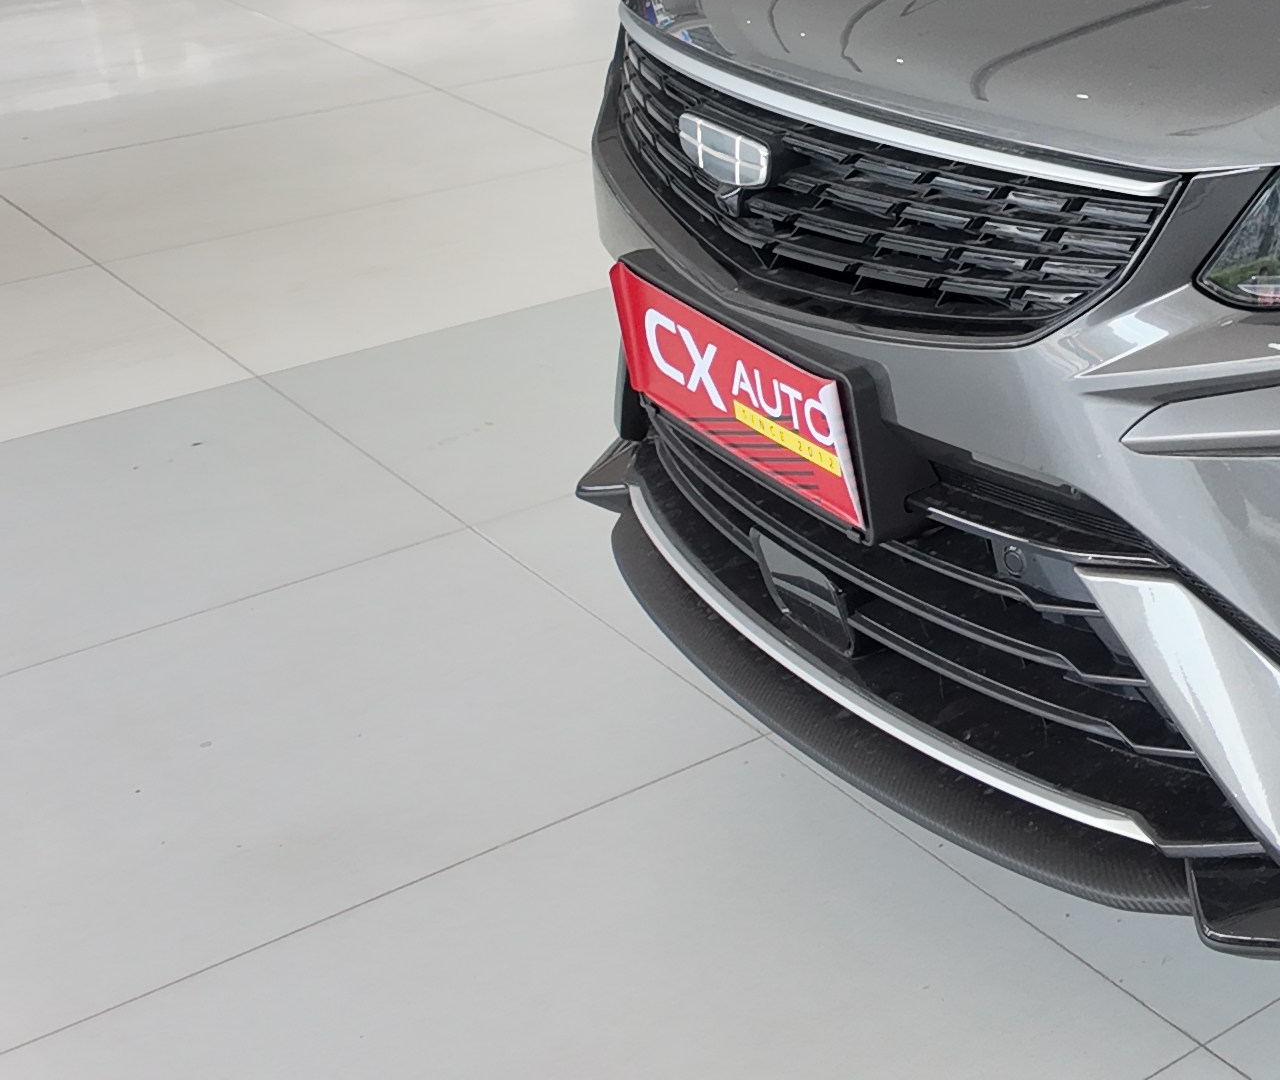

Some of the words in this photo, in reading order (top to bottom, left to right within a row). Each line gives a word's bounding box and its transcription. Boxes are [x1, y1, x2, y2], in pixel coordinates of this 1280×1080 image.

[644, 308, 727, 413] CX
[732, 359, 835, 447] AUTO
[741, 408, 786, 442] SINCE
[796, 440, 835, 470] 2012
